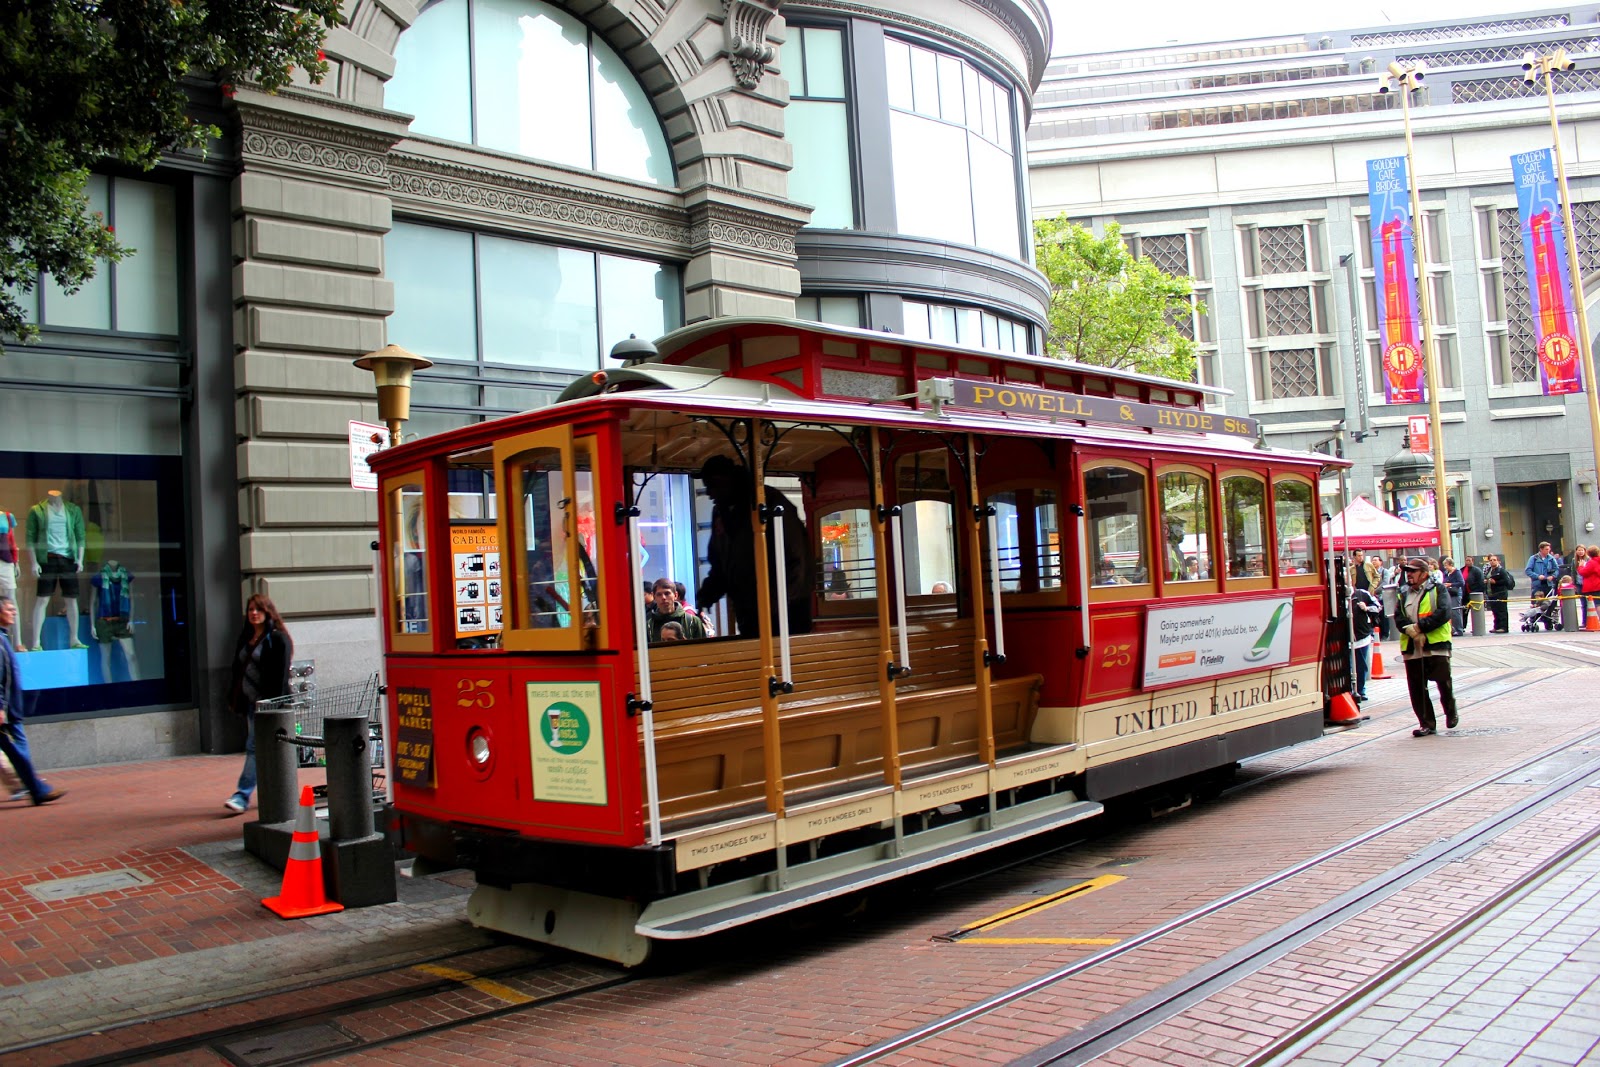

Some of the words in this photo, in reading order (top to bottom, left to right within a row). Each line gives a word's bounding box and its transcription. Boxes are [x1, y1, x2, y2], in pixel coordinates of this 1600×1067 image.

[1373, 158, 1400, 170] GOLDEN
[1517, 150, 1546, 165] GOLDEN
[1378, 169, 1396, 180] GATE
[1524, 162, 1542, 173] GATE
[1376, 179, 1401, 191] BRIDGE
[1522, 171, 1547, 185] BRIDGE
[1373, 188, 1408, 234] 75
[1520, 180, 1557, 227] 75
[973, 386, 1093, 417] POWELL
[1119, 404, 1135, 421] &
[1158, 409, 1213, 430] HYDE
[1223, 418, 1251, 434] Sts.
[1397, 490, 1435, 511] LOVE
[452, 536, 488, 545] CABLE
[1160, 620, 1179, 631] Going
[1180, 615, 1214, 629] somewhere?
[1160, 633, 1180, 646] Maybe
[1181, 633, 1194, 644] your
[1195, 629, 1204, 640] old
[1205, 627, 1221, 639] 401(k)
[1222, 625, 1239, 636] should
[1102, 644, 1132, 668] 25
[1206, 655, 1225, 665] Fidelity
[398, 693, 431, 707] POWELL
[457, 678, 496, 709] 25
[406, 706, 424, 716] AND
[1114, 699, 1198, 737] UNITED
[399, 715, 432, 730] MARKET
[1024, 765, 1048, 776] STANDEES
[919, 792, 931, 800] TWO
[932, 785, 960, 797] STANDEES
[961, 782, 974, 790] ONLY
[808, 818, 823, 828] TWO
[823, 810, 856, 825] STANDEES
[857, 807, 873, 816] ONLY
[691, 846, 708, 857] TWO
[709, 835, 748, 853] STANDEES
[750, 832, 768, 843] ONLY
